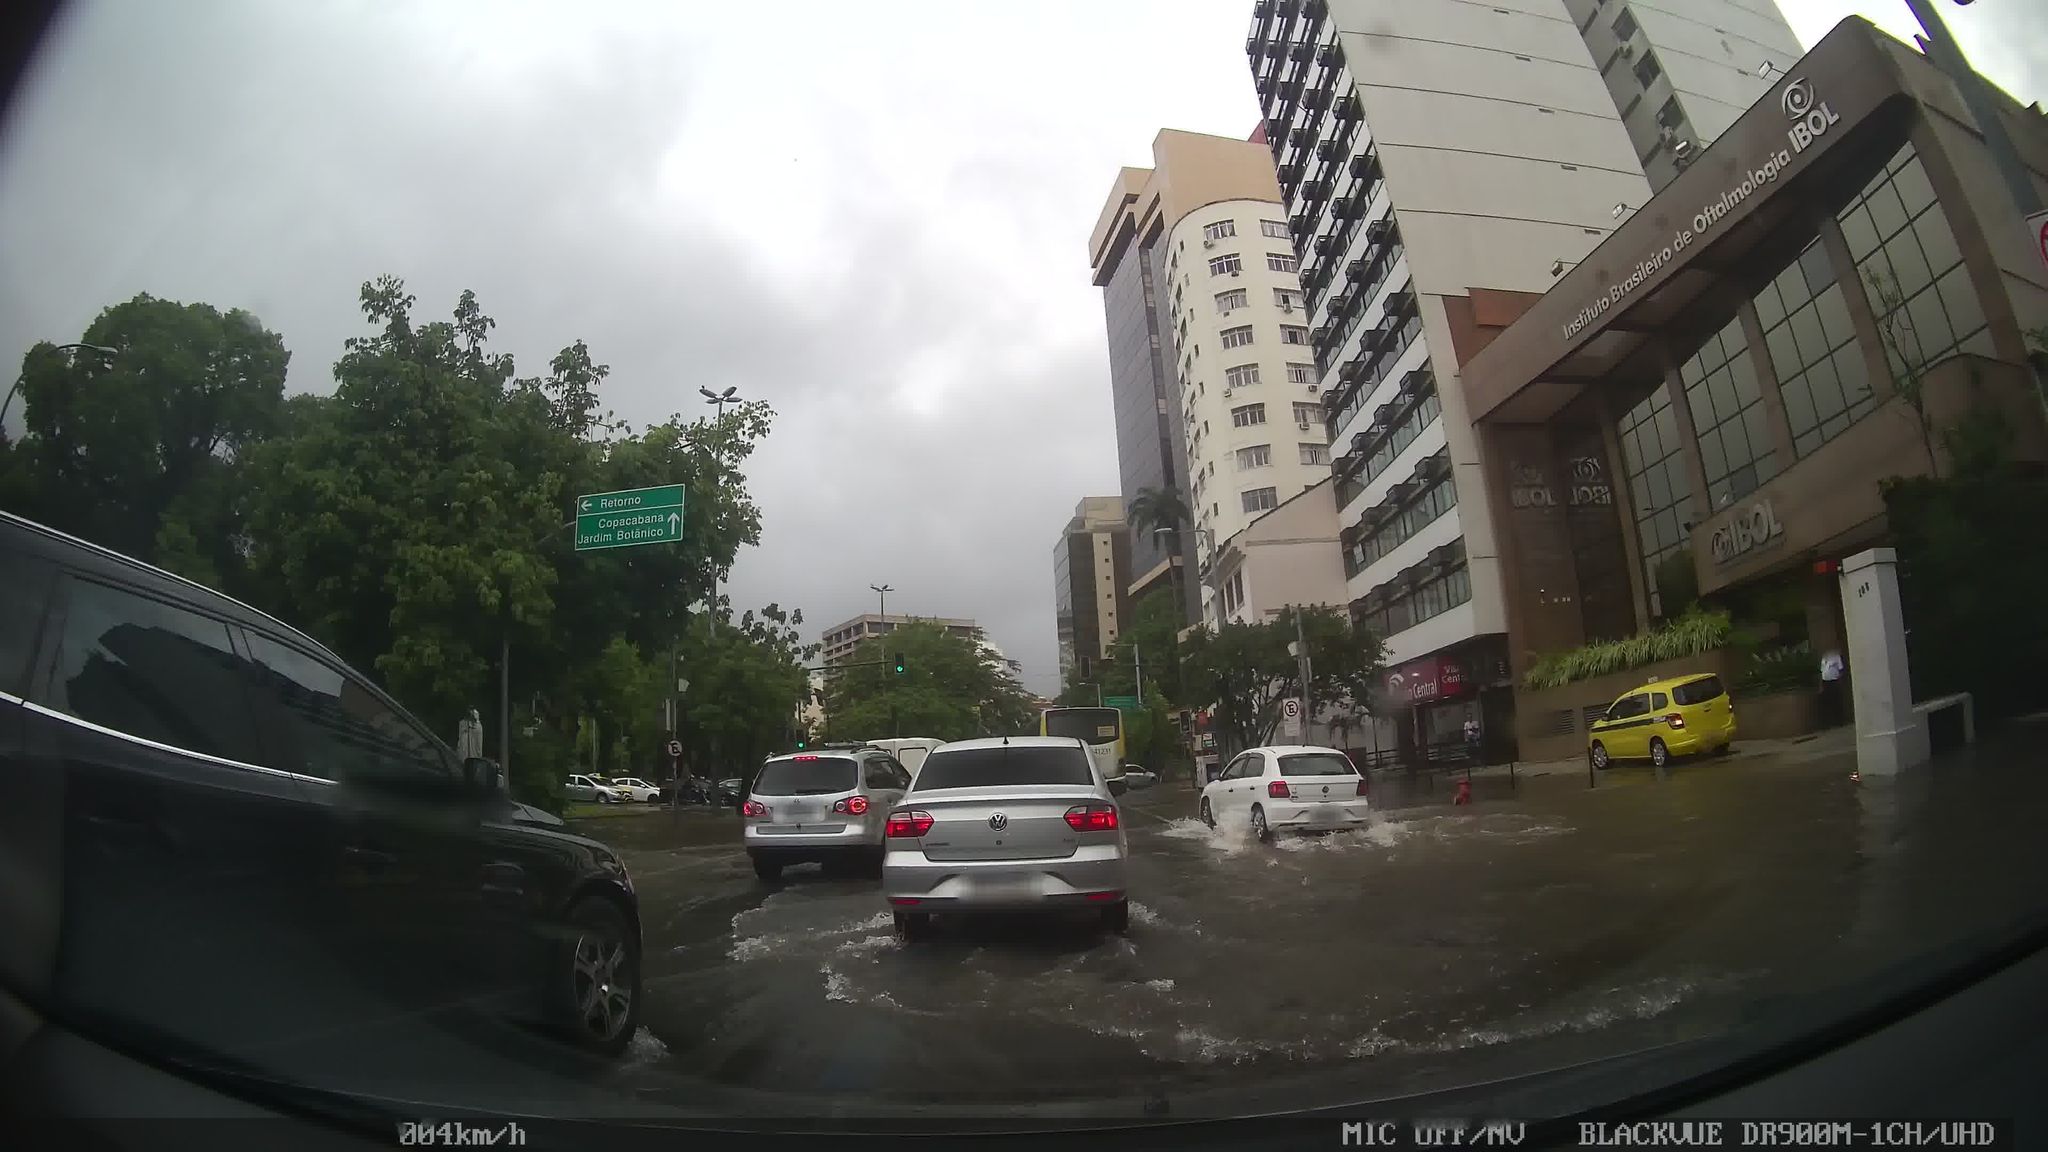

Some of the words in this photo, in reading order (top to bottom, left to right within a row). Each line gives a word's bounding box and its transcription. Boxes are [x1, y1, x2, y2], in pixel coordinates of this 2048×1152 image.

[1562, 295, 1610, 340] Instituto
[1608, 247, 1672, 305] Brasileiro
[1673, 228, 1694, 252] de
[1693, 149, 1792, 234] Oftalmologia
[1786, 101, 1840, 154] IBOL
[600, 496, 641, 509] Retorno
[598, 514, 664, 529] Copacabana
[1728, 498, 1784, 556] IBOL
[577, 533, 612, 545] Jardim
[616, 528, 664, 541] Botânico
[1412, 678, 1438, 699] Central
